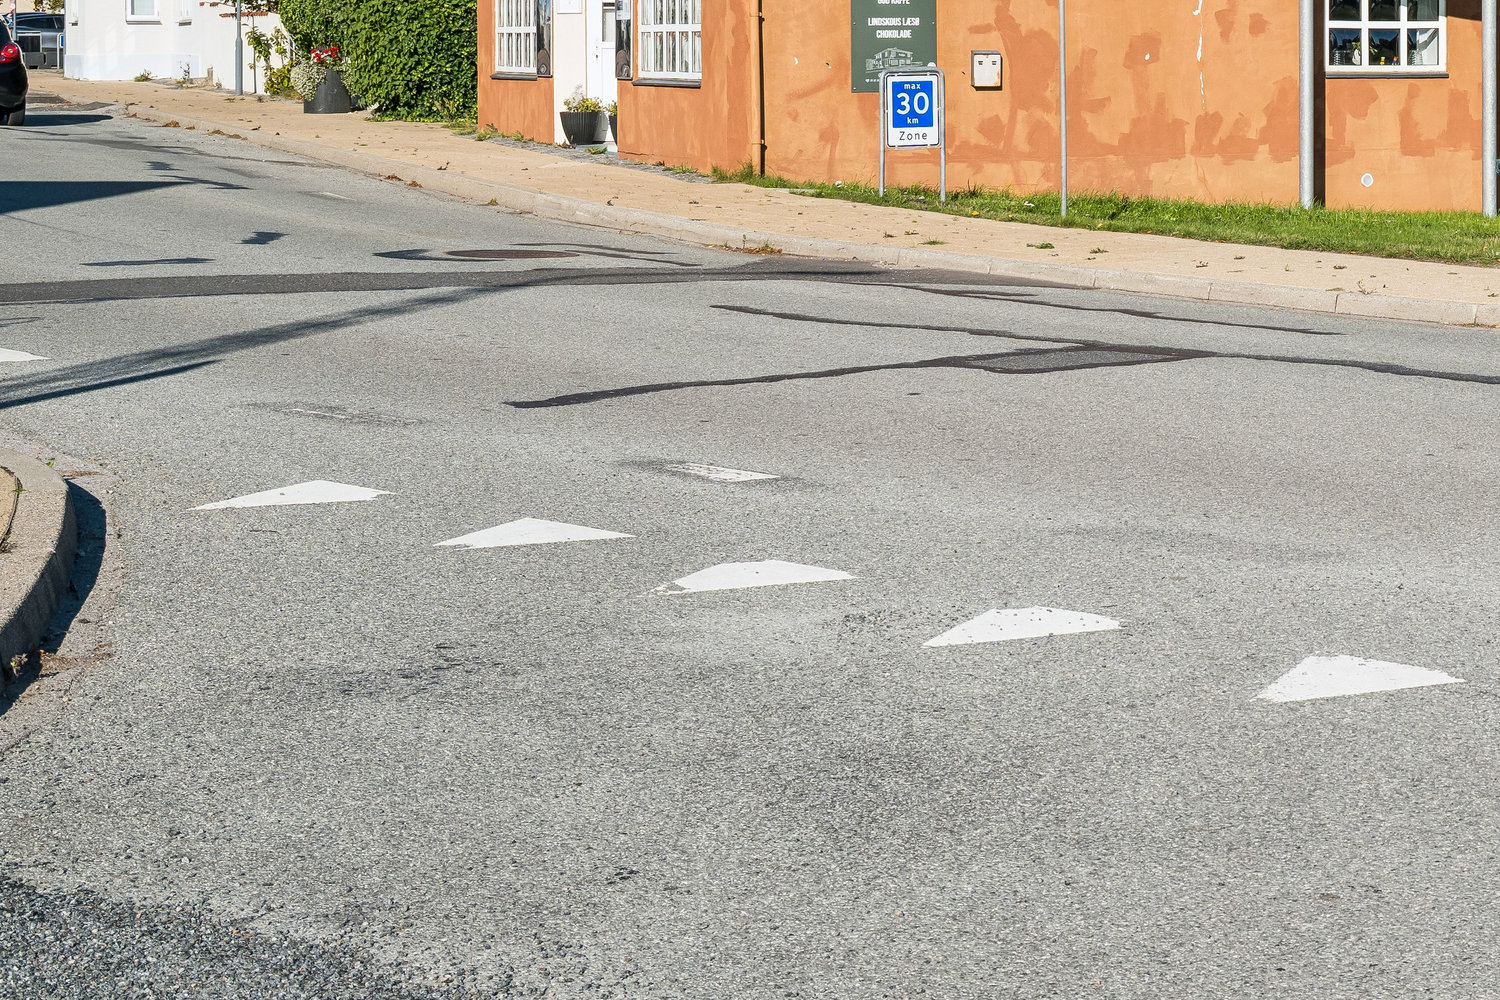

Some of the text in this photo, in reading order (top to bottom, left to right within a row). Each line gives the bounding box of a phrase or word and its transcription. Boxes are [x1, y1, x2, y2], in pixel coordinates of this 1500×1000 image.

[876, 29, 912, 39] CHOKOLADE
[896, 91, 930, 115] 30
[899, 131, 928, 141] Zone
